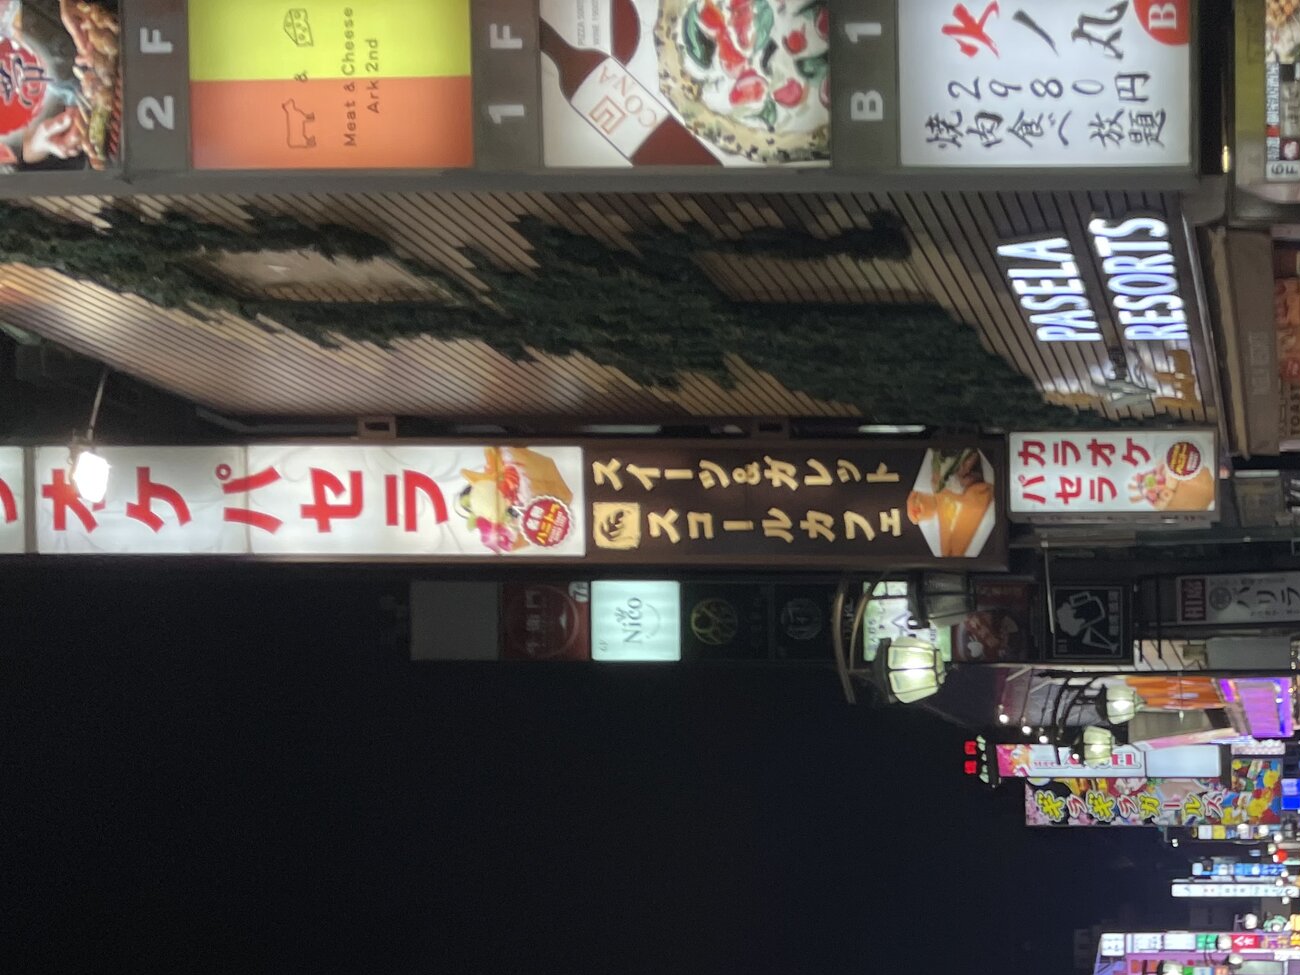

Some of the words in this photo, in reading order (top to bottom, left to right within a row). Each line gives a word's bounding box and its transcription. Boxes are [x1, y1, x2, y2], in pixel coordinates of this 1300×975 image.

[340, 6, 356, 77] Cheese
[940, 0, 1130, 60] 火ノ丸
[364, 37, 380, 73] 2nd
[343, 81, 357, 92] &
[365, 81, 380, 115] Ark
[946, 72, 1151, 103] 2980円
[342, 101, 357, 147] Meat
[924, 108, 1167, 150] 焼肉食べ放題
[996, 236, 1103, 342] PASELA
[1088, 216, 1188, 341] RESORTS
[1018, 437, 1151, 468] カラオケ
[591, 454, 901, 492] スイーツ&ガレット
[1018, 474, 1118, 505] パセラ
[0, 463, 449, 534] オケパセラ
[648, 507, 902, 545] スコールカフェ
[621, 597, 643, 644] Nico
[1034, 790, 1225, 822] ギラギラガールズ
